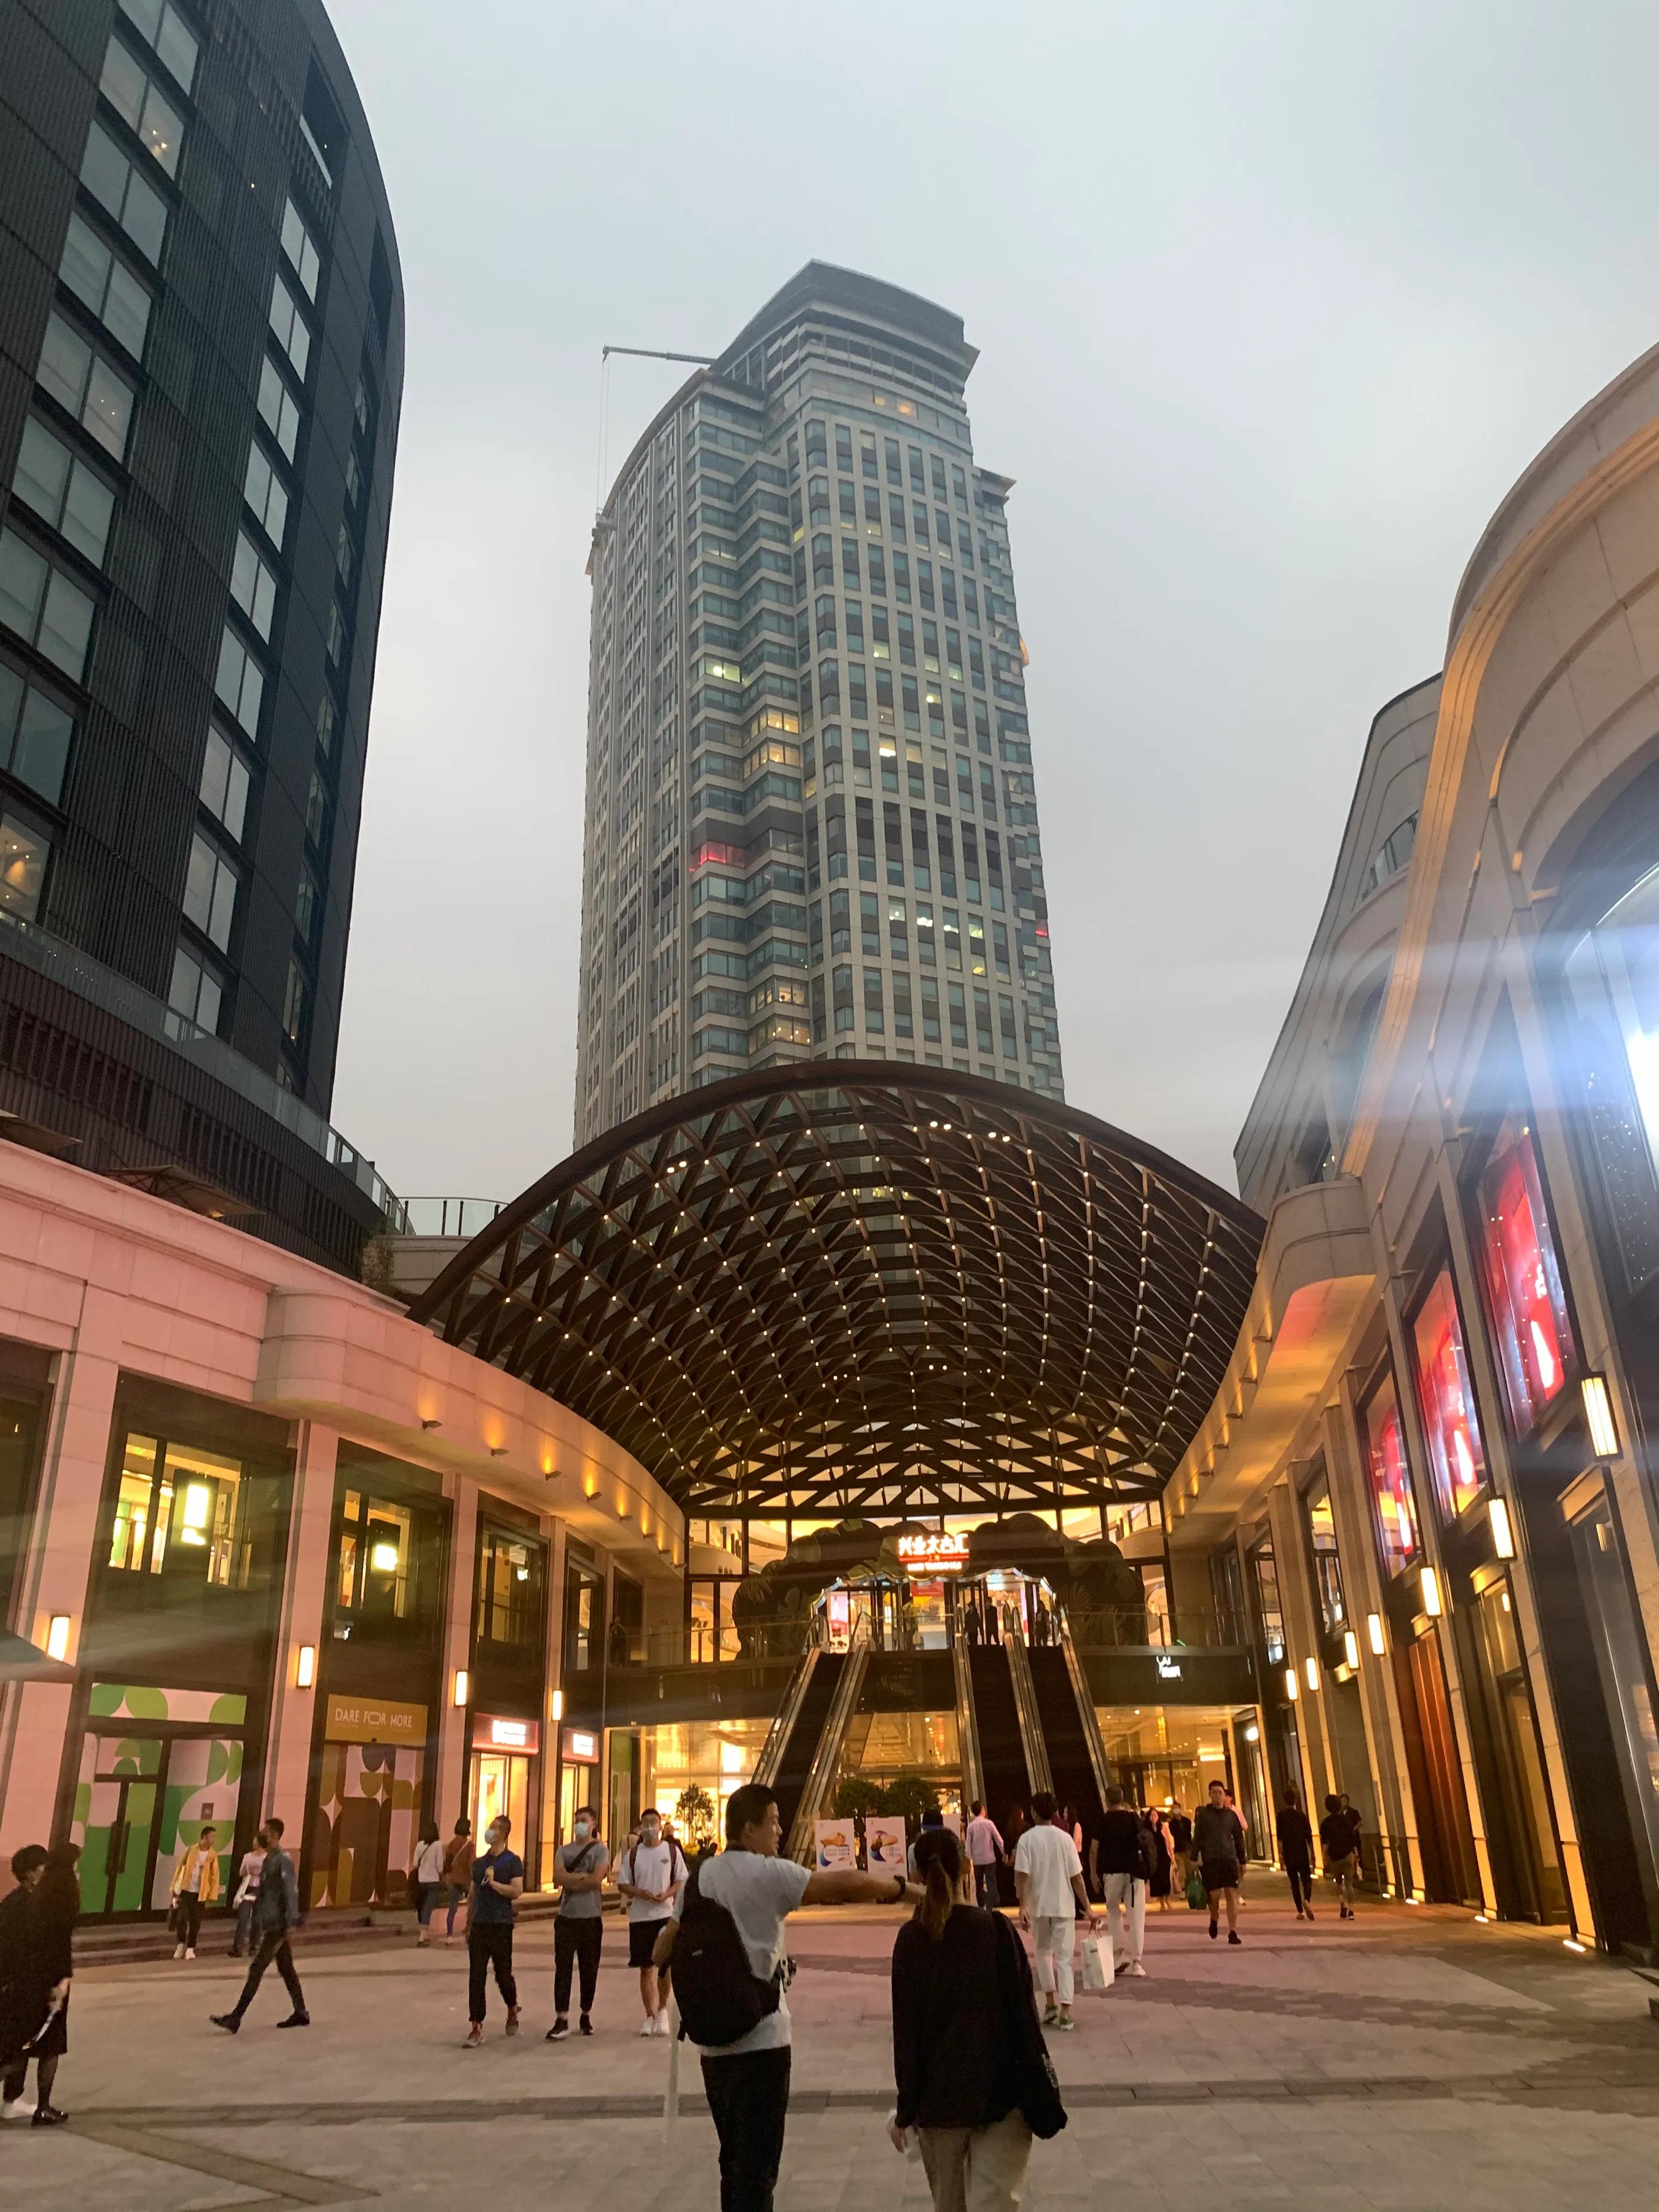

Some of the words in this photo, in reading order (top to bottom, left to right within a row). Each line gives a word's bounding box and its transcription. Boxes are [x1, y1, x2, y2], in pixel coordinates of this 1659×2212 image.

[335, 1708, 360, 1723] DARE
[364, 1711, 386, 1725] FOR
[390, 1714, 412, 1728] MORE
